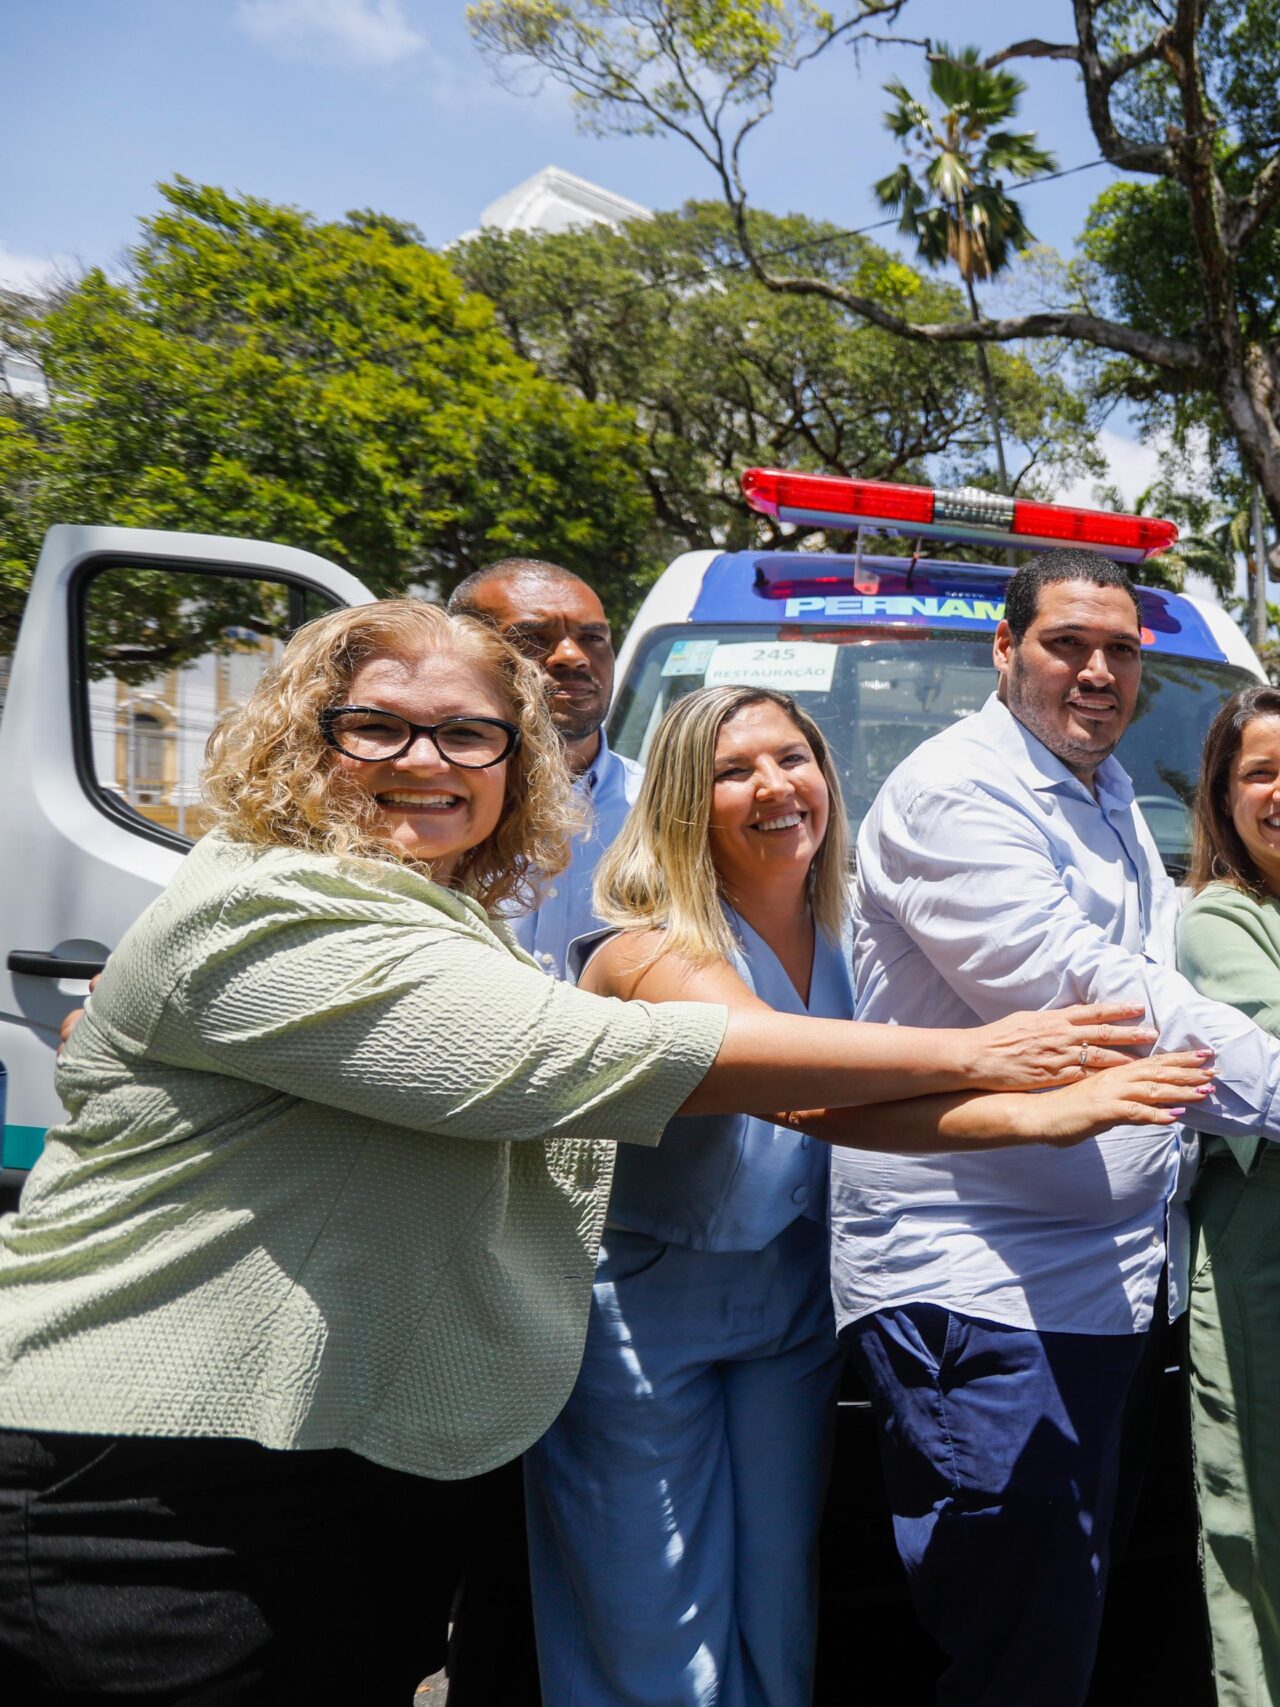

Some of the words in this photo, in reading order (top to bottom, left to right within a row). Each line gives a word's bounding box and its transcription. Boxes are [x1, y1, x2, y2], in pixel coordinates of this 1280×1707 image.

[785, 597, 1006, 621] PERNAM
[752, 649, 795, 661] 245
[713, 667, 827, 679] RESTAURAÇÃO
